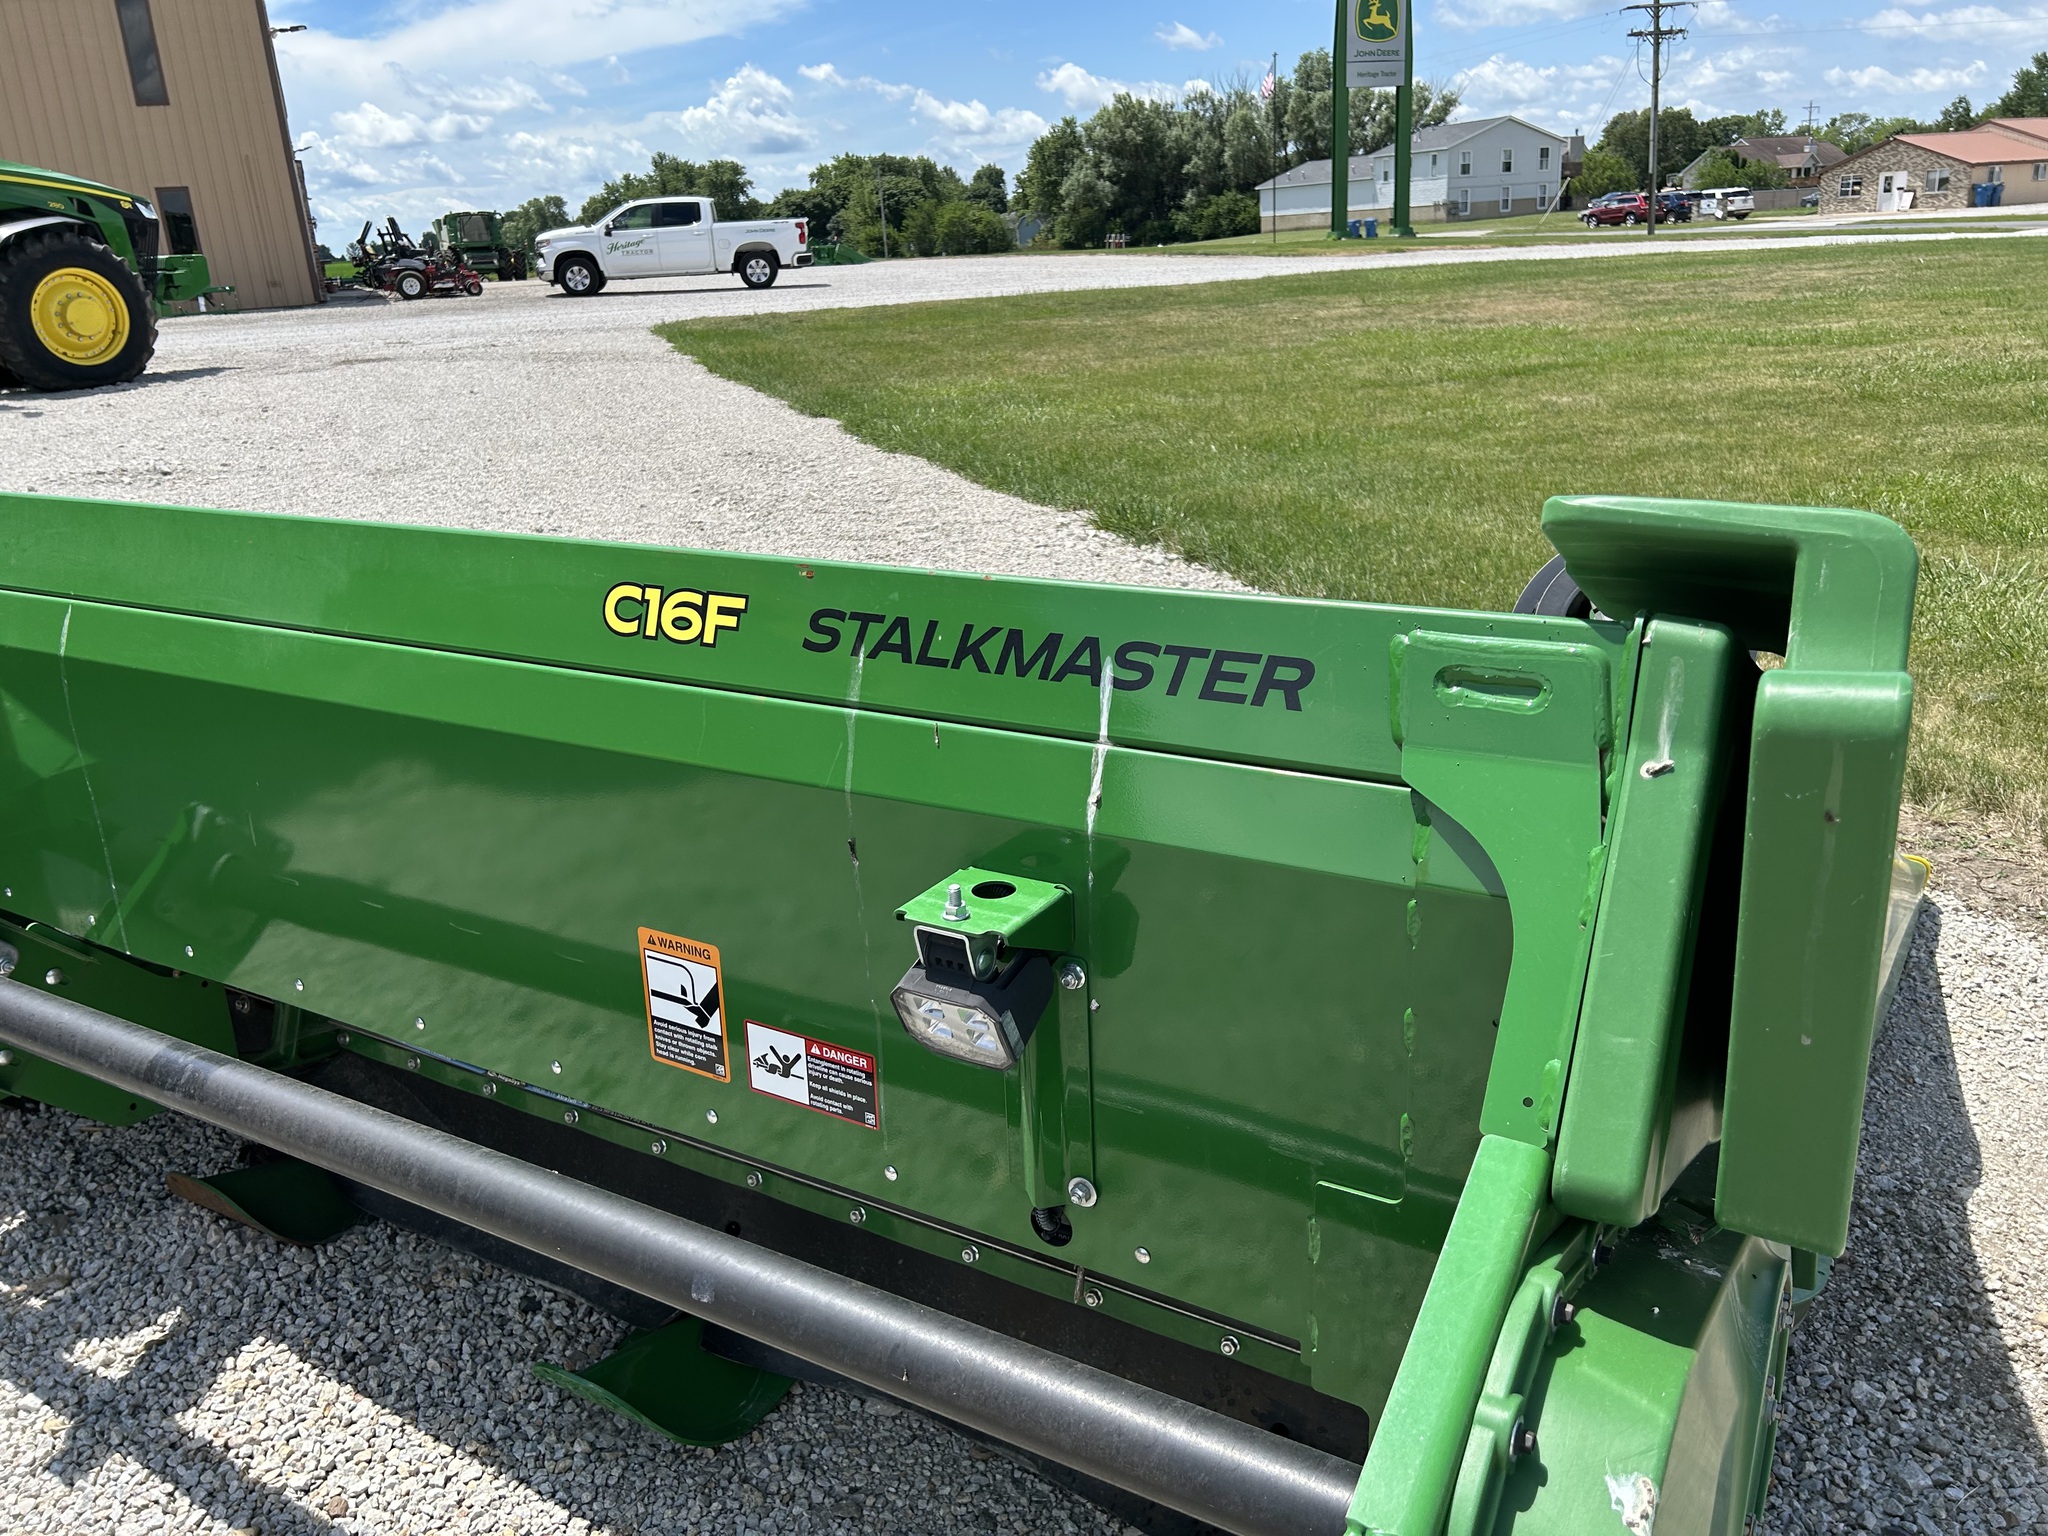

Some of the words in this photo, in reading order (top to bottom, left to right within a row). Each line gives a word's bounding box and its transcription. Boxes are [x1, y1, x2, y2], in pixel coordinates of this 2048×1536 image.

[1354, 49, 1376, 57] JOHN
[1376, 48, 1400, 57] DEERE
[606, 239, 645, 255] Heritage
[602, 581, 748, 648] C16F
[802, 608, 1315, 712] STALKMASTER
[657, 936, 711, 960] WARNING
[654, 1020, 667, 1028] Avoid
[669, 1024, 687, 1034] serious
[688, 1030, 702, 1039] injury
[654, 1028, 672, 1036] contact
[685, 1037, 704, 1047] rotating
[655, 1034, 671, 1043] knives
[678, 1041, 695, 1051] thrown
[656, 1041, 666, 1049] Stay
[823, 1047, 867, 1068] DANGER
[808, 1056, 840, 1070] Entanglement
[847, 1068, 865, 1079] rotating
[808, 1070, 822, 1078] injury
[808, 1063, 828, 1072] driveline
[839, 1072, 853, 1080] cause
[854, 1076, 872, 1086] serious
[809, 1081, 821, 1090] Keep
[829, 1086, 846, 1097] shields
[811, 1093, 823, 1101] Avoid
[824, 1098, 842, 1108] contact
[811, 1100, 828, 1111] rotating
